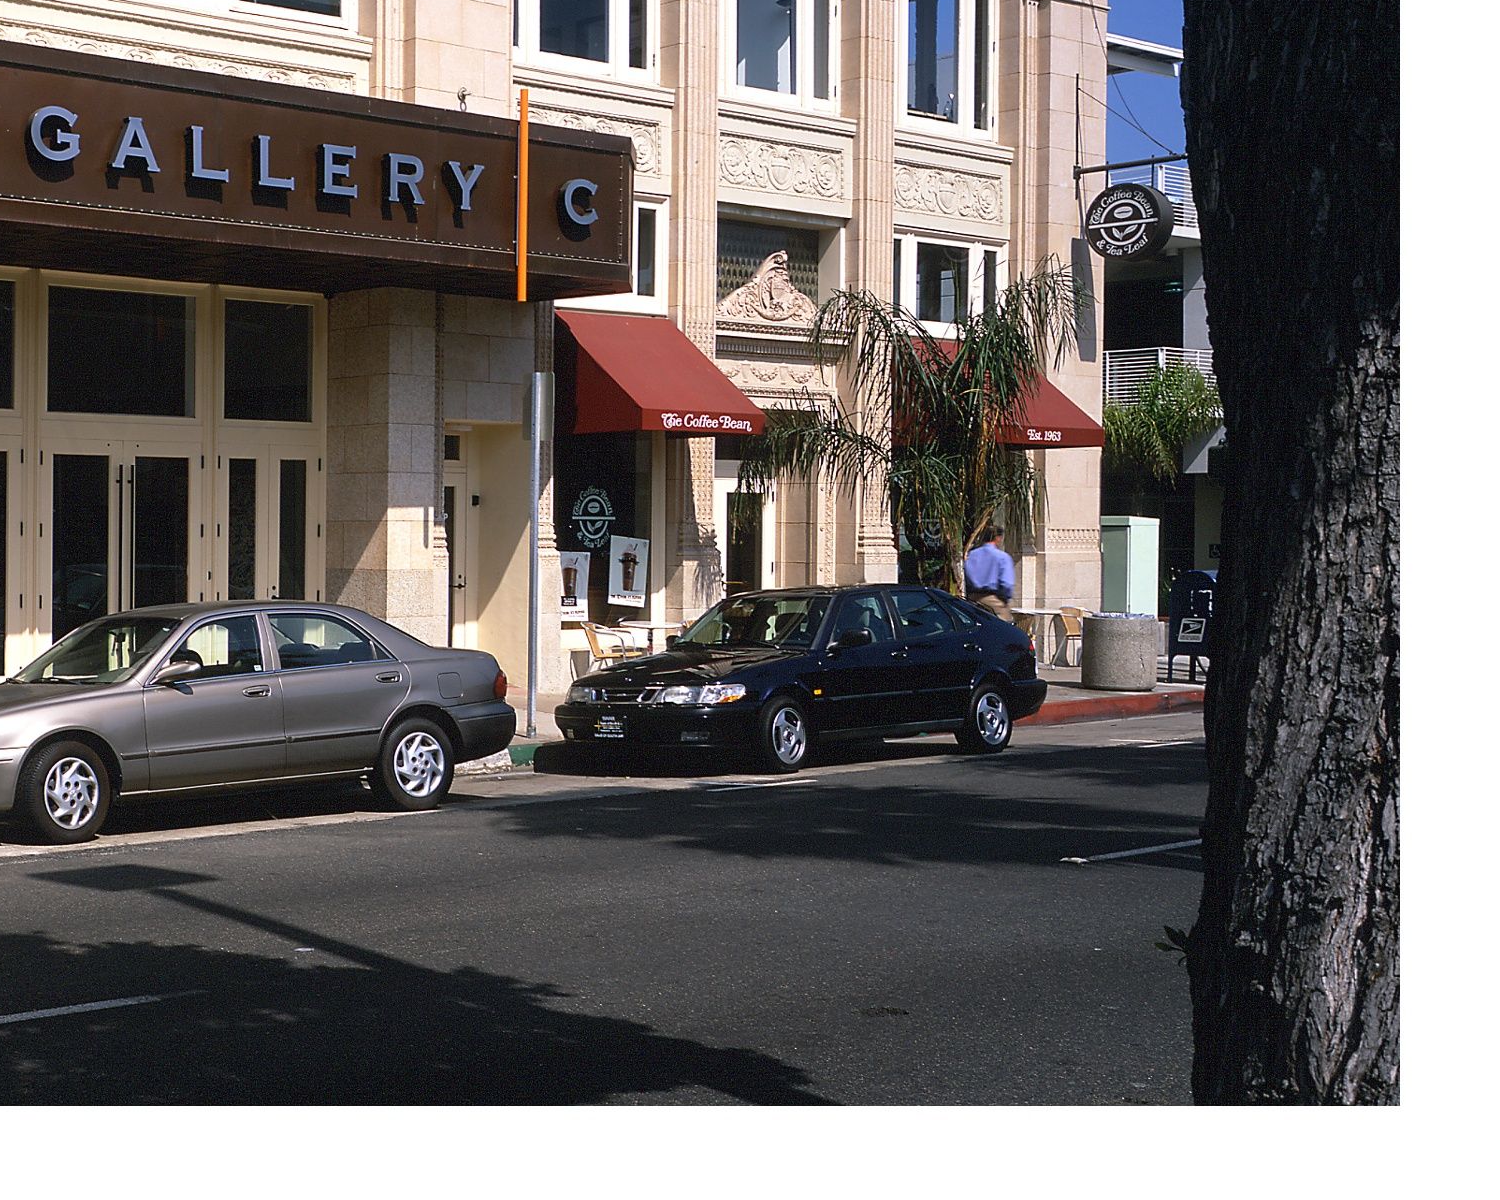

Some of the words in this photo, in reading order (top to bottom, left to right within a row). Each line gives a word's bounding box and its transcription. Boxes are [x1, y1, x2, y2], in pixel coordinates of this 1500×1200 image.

[30, 105, 485, 211] GALLERY
[564, 178, 599, 226] C
[1089, 207, 1103, 225] The
[1100, 190, 1132, 207] Coffee
[1133, 190, 1154, 218] Bean
[1096, 239, 1106, 249] &
[1106, 244, 1123, 256] Tea
[1124, 233, 1149, 254] Leaf
[661, 413, 682, 429] The
[684, 413, 718, 429] Coffee
[719, 415, 752, 432] Bean
[1027, 429, 1043, 441] Est.
[1044, 430, 1062, 442] 1963
